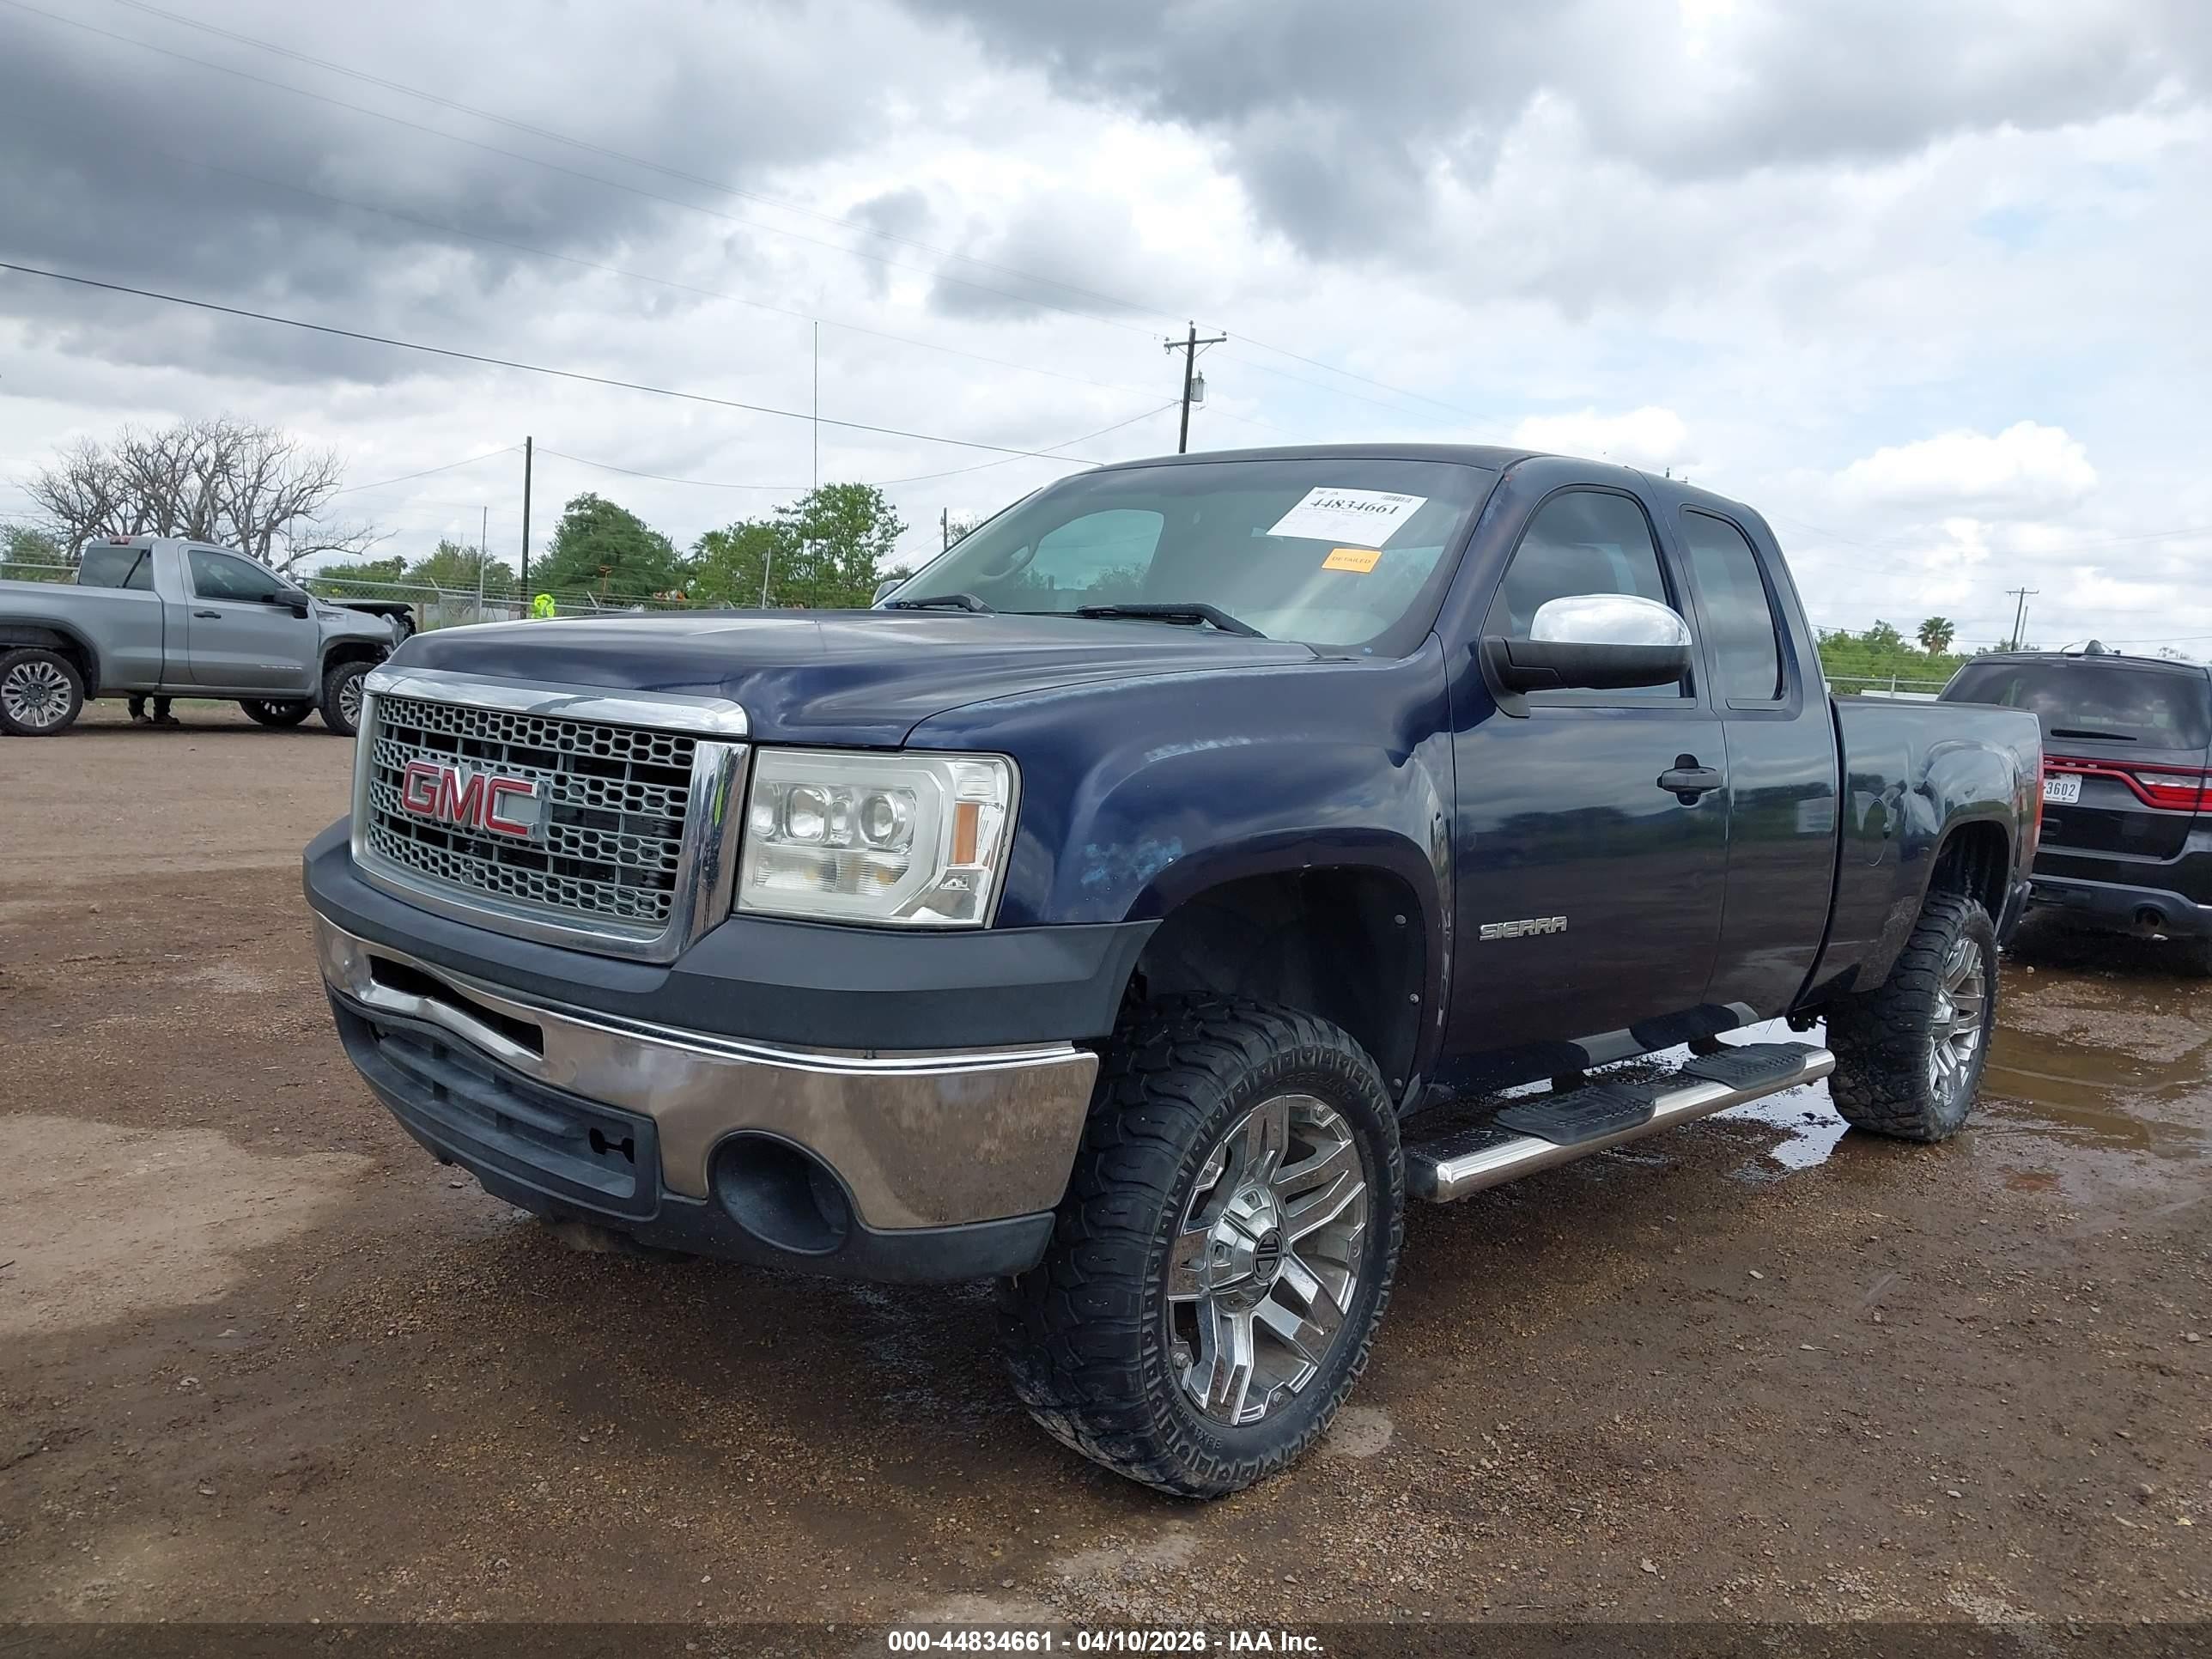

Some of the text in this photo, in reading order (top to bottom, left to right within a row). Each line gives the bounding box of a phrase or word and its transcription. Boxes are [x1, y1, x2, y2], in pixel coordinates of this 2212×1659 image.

[1310, 498, 1400, 515] 44834661
[402, 760, 540, 839] GMC
[2046, 782, 2076, 797] 3602
[1480, 916, 1567, 941] SIERRA
